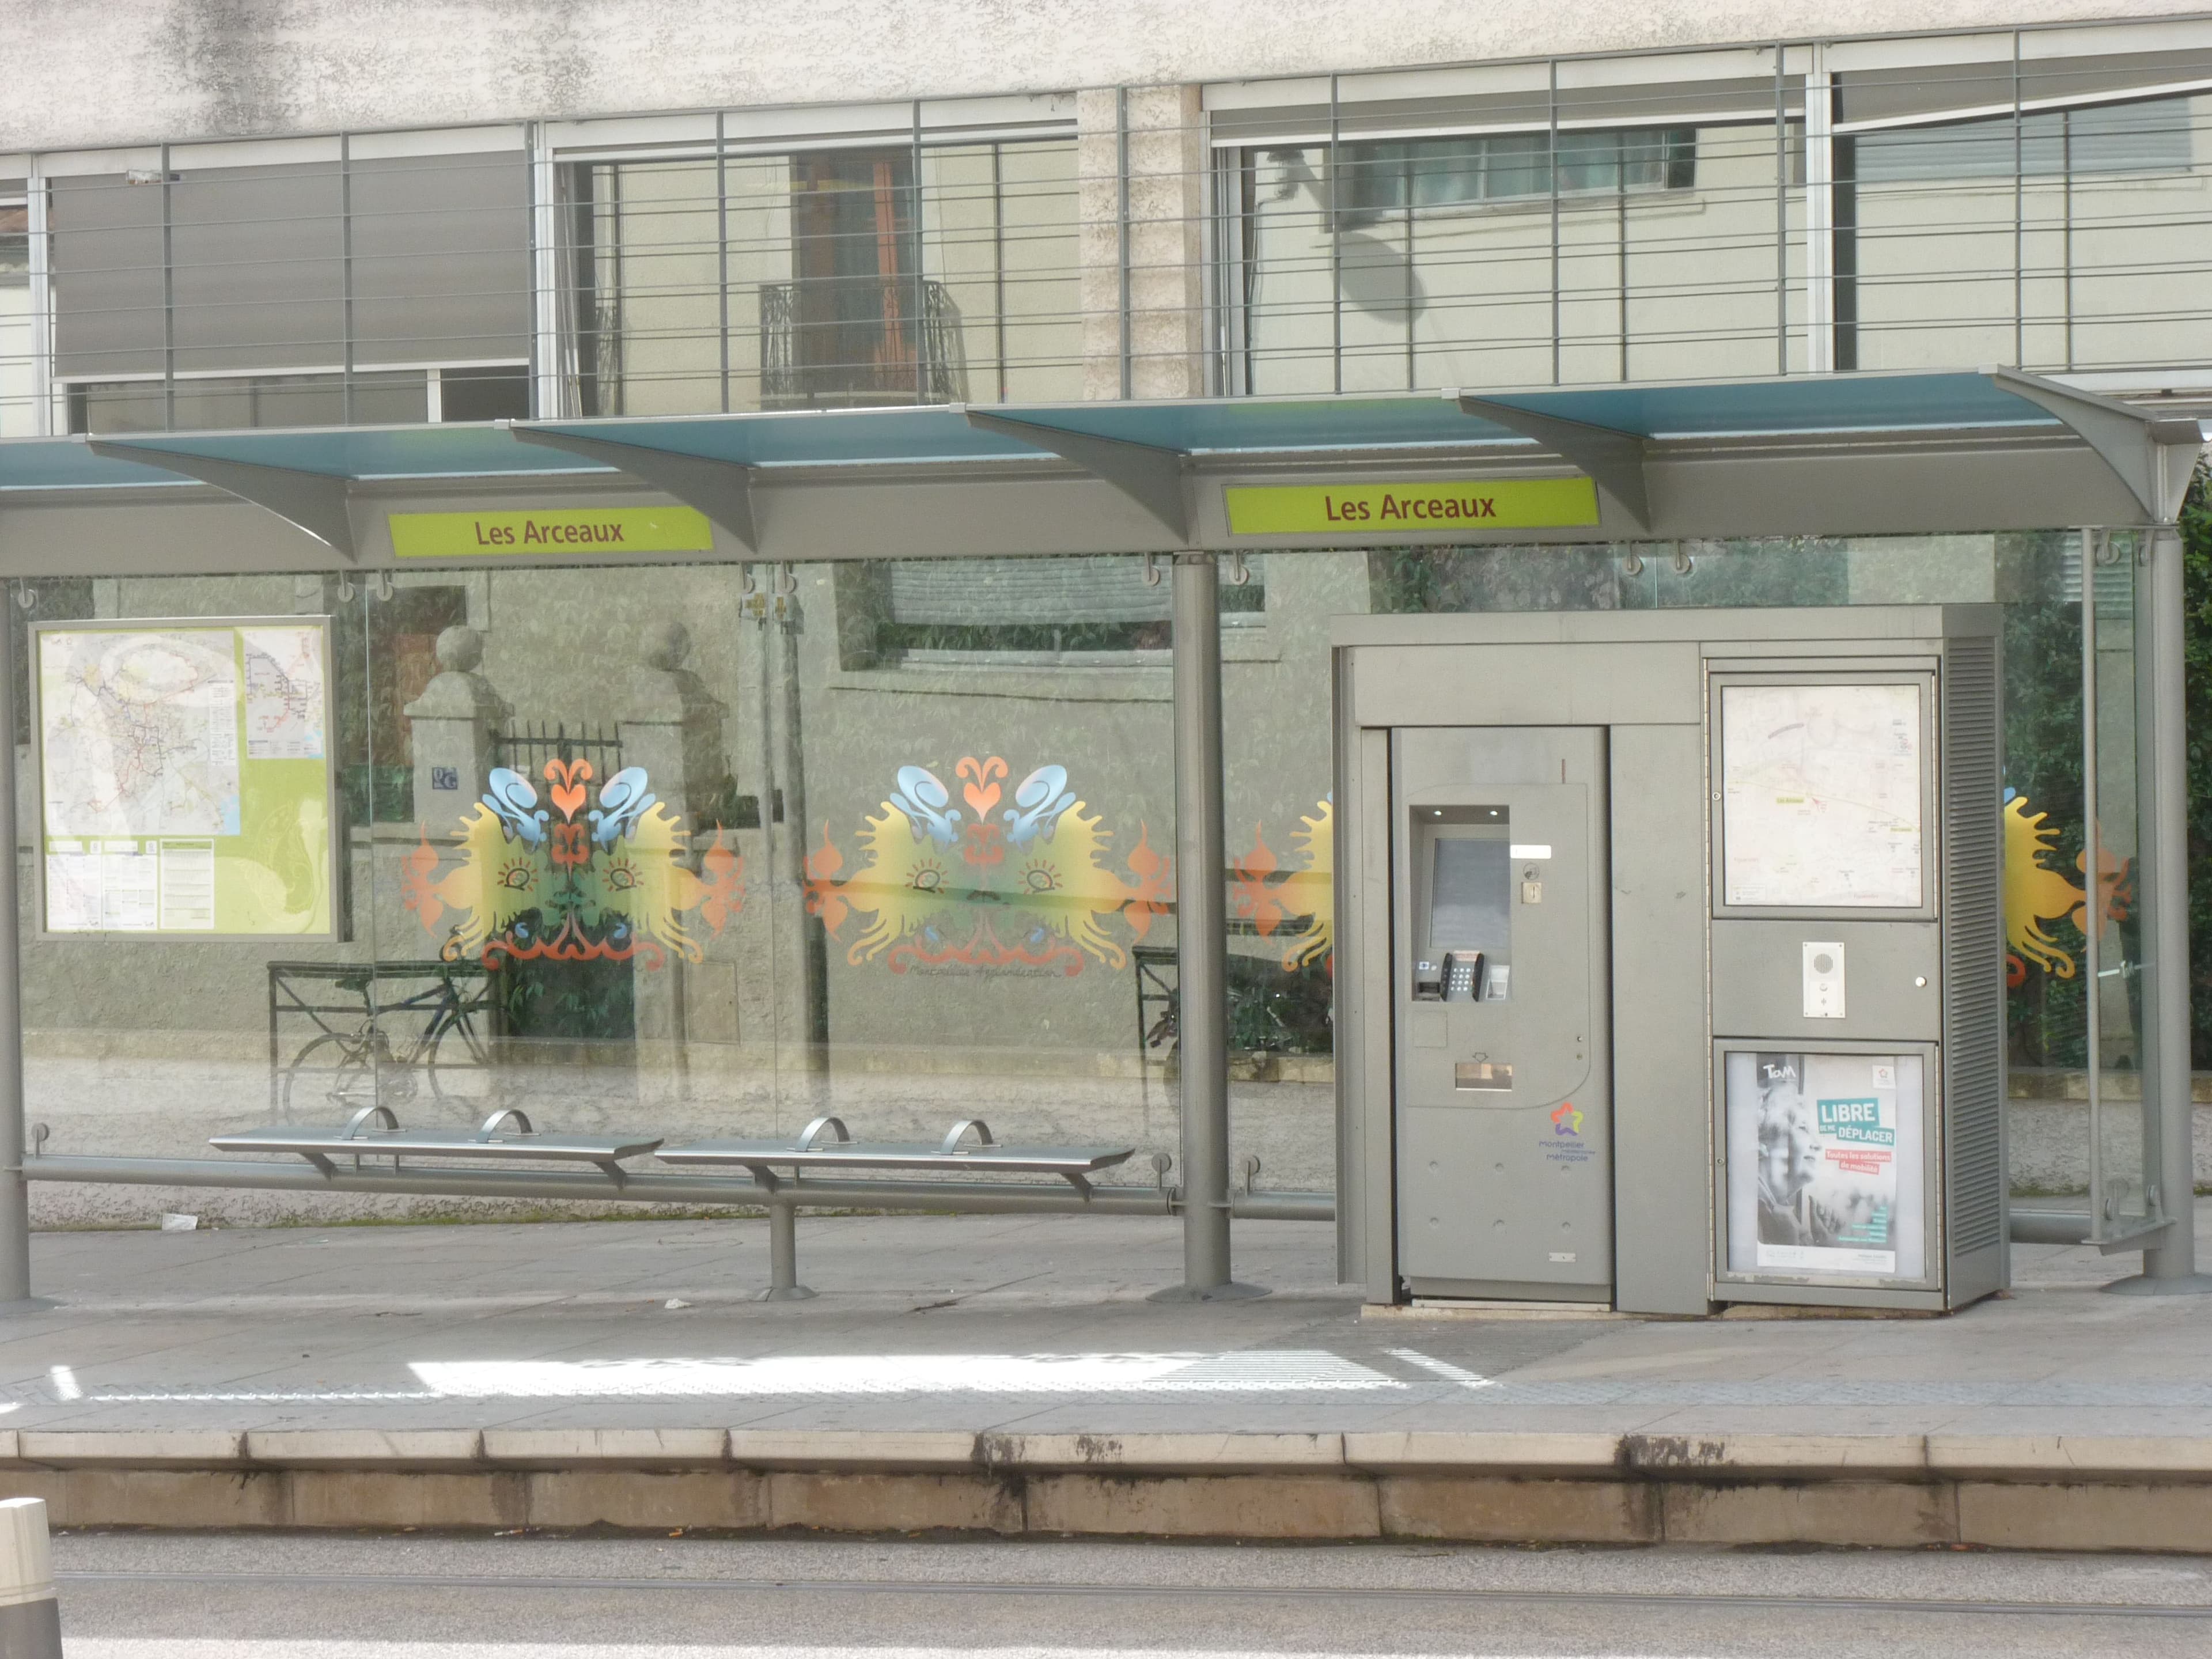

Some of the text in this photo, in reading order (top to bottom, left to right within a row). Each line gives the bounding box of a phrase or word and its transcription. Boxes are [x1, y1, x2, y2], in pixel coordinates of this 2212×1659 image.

[1325, 494, 1497, 521] Les Arceaux
[475, 520, 625, 546] Les Arceaux
[1763, 1064, 1797, 1079] TaM
[1821, 1103, 1876, 1123] LIBRE
[1838, 1125, 1893, 1143] DÉPLACER
[1547, 1153, 1588, 1162] métropole
[1827, 1151, 1891, 1161] Toutes les solutions
[1850, 1162, 1878, 1173] mobilité
